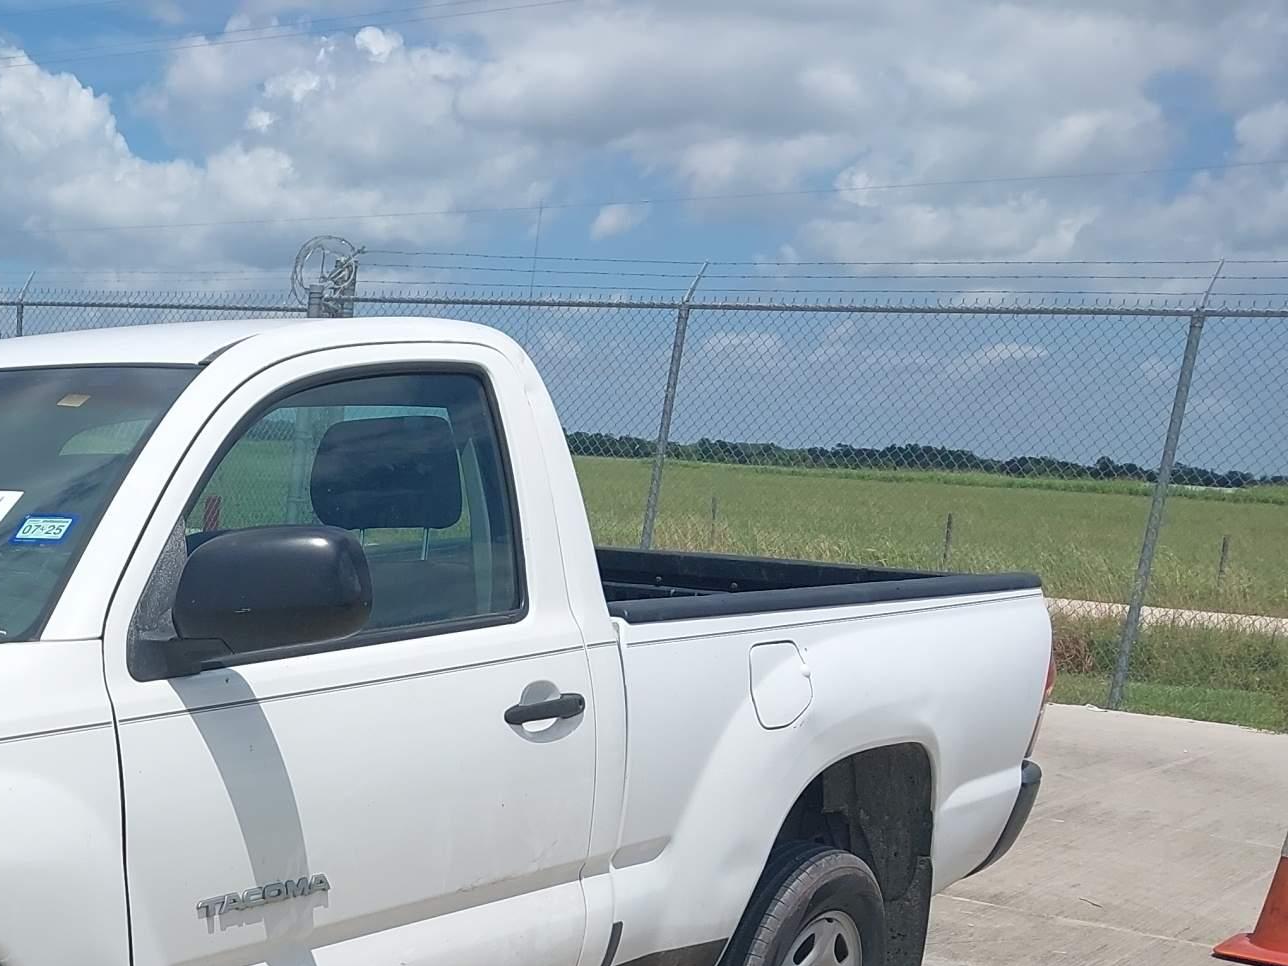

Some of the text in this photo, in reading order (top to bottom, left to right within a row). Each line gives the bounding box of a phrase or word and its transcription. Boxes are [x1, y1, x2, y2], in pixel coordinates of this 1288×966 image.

[22, 524, 65, 536] 07 25
[196, 872, 332, 917] TACOMA
